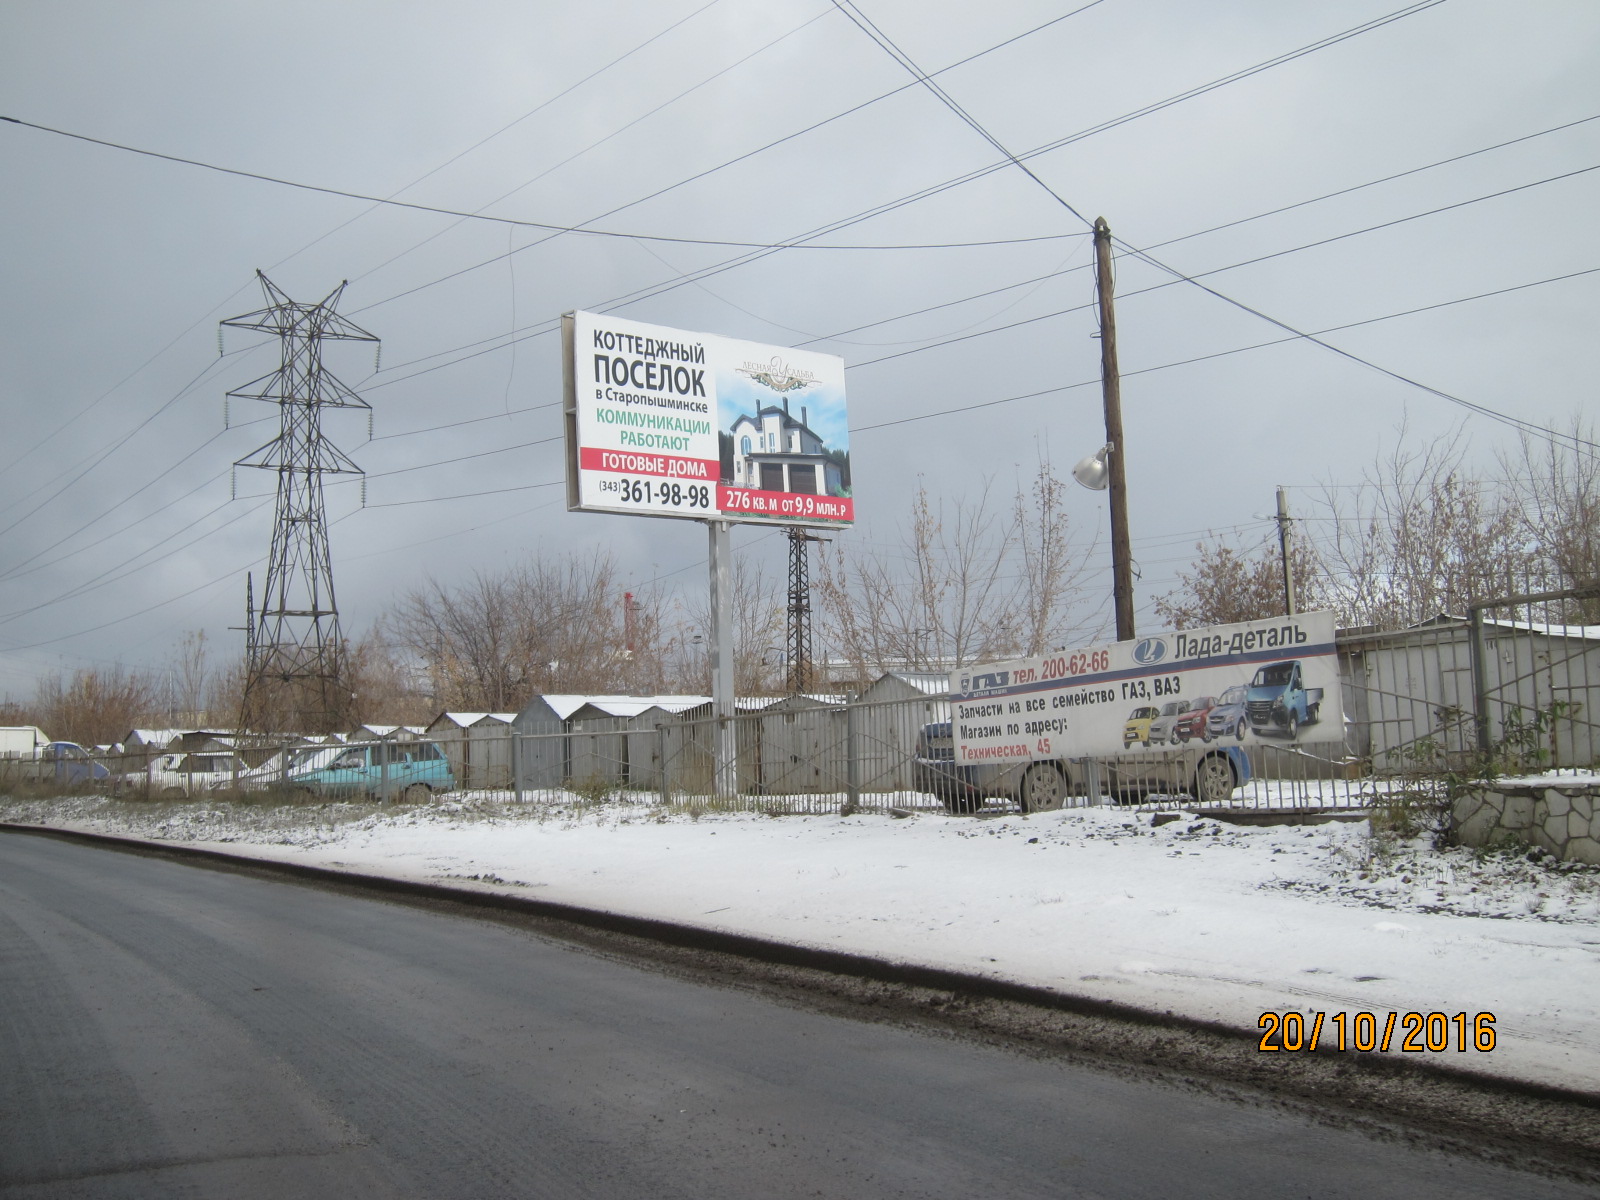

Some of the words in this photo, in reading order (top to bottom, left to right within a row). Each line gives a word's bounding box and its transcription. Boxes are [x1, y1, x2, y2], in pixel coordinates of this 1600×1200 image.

[593, 329, 705, 365] КОТТЕДЖНЫЙ
[594, 353, 706, 397] ПОСЕЛОК
[595, 389, 603, 400] в
[605, 387, 708, 414] Старопышминске
[596, 408, 710, 436] КОММУНИКАЦИИ
[620, 430, 690, 451] РАБОТАЮТ
[602, 452, 665, 473] ГОТОВЫЕ
[667, 459, 708, 478] ДОМА
[726, 490, 750, 509] 276
[795, 496, 814, 516] 9,9
[1174, 624, 1307, 660] Лада-деталь
[972, 671, 1009, 690] ГАЗ
[1013, 668, 1038, 685] тел.
[1041, 650, 1109, 680] 200-62-66
[958, 701, 1003, 720] Запчасти
[1009, 701, 1021, 714] на
[1026, 698, 1046, 713] все
[1052, 688, 1115, 709] семейство
[1122, 680, 1151, 701] ГАЗ,
[1154, 675, 1181, 697] ВАЗ
[960, 724, 1002, 740] Магазин
[1007, 723, 1020, 736] по
[1025, 717, 1068, 736] адресу:
[961, 744, 1032, 761] Техническая,
[1037, 738, 1051, 755] 45
